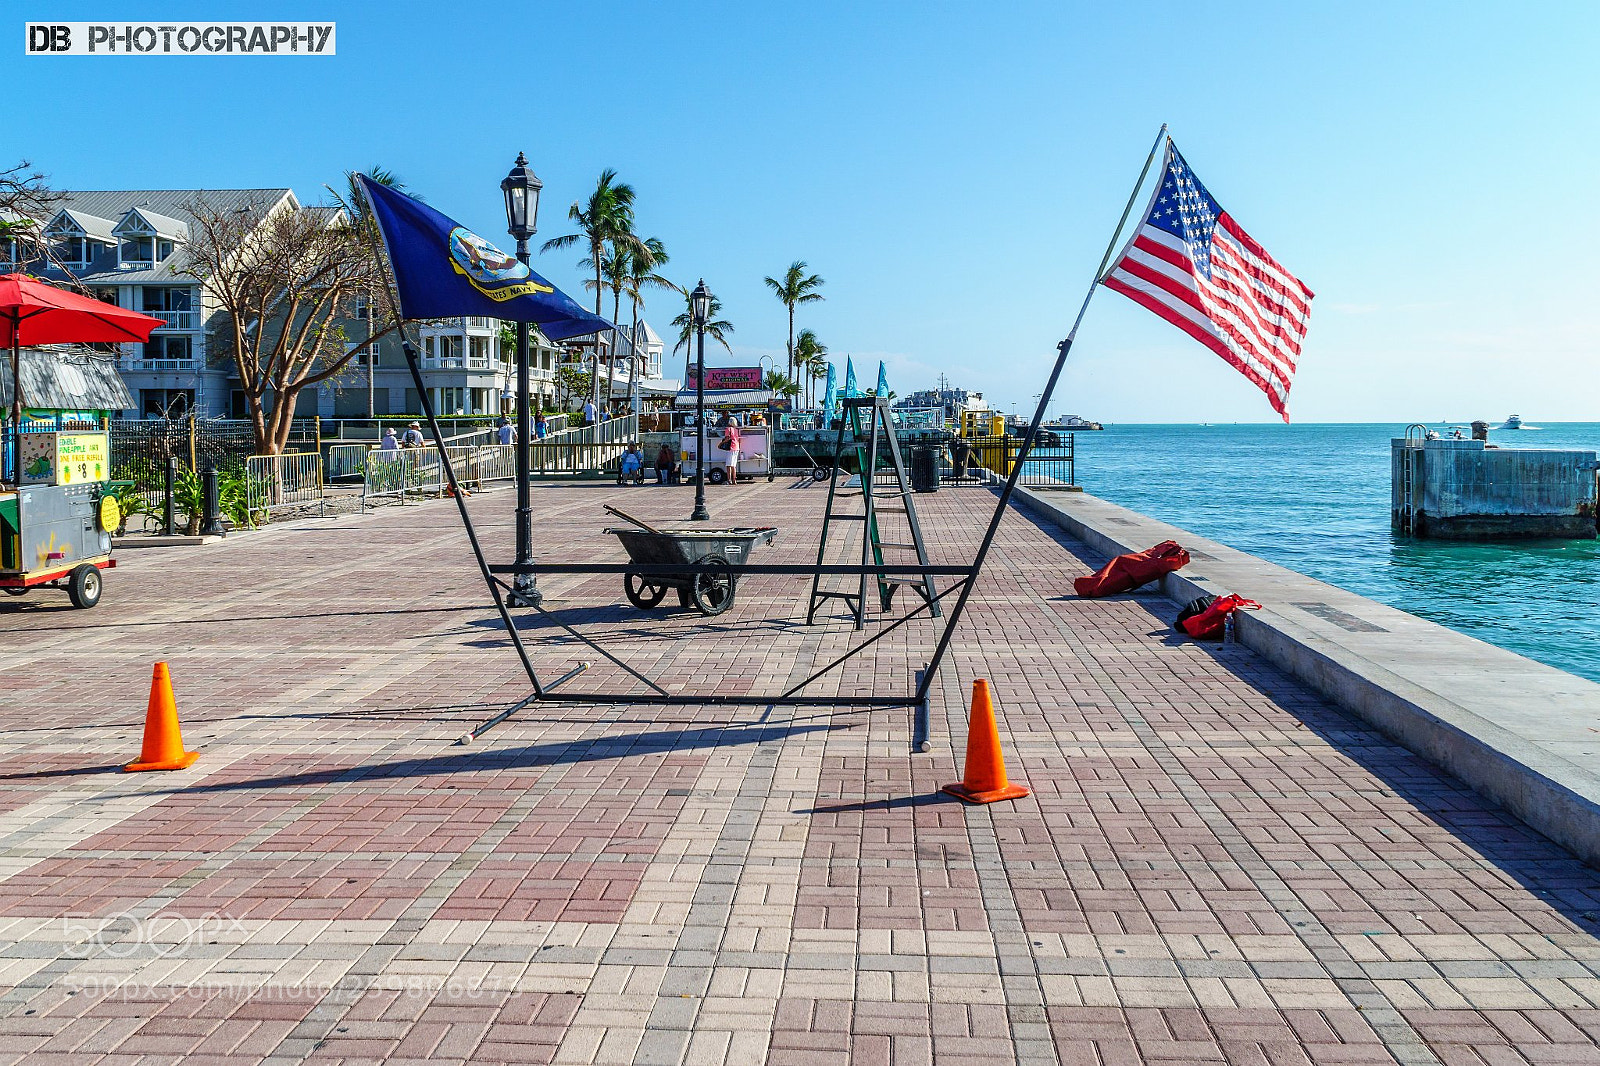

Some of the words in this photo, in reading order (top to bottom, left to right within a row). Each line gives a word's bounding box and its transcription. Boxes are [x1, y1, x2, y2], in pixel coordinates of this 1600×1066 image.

[510, 287, 531, 295] NAVY
[712, 372, 727, 380] KEY
[59, 438, 76, 446] EDIBLE
[59, 445, 86, 454] PINEAPPLE
[60, 455, 70, 463] ONE
[72, 454, 85, 462] FREE
